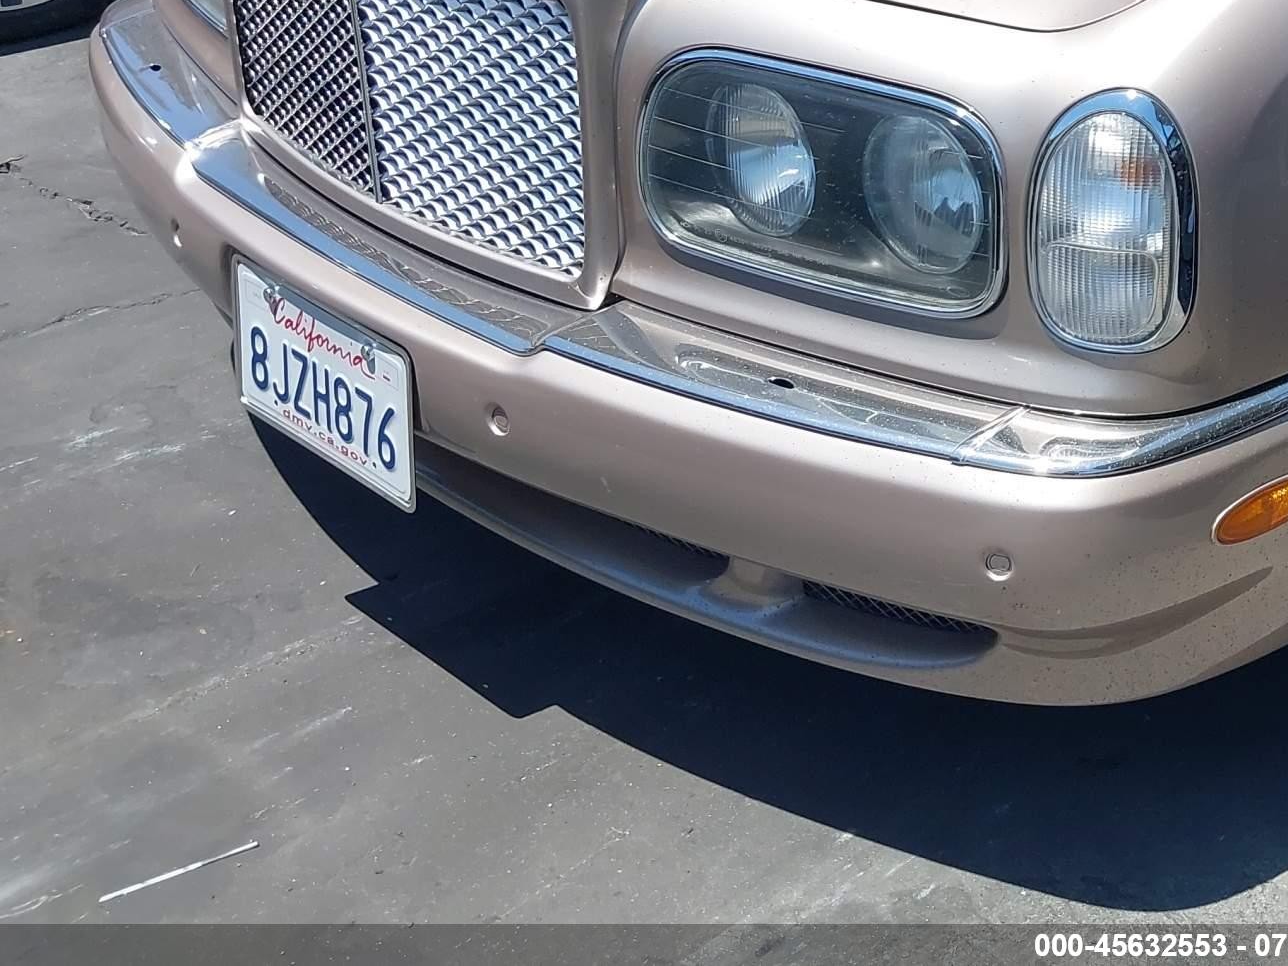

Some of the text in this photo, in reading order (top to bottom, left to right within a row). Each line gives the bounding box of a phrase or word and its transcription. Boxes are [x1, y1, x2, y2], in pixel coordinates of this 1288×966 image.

[271, 296, 376, 380] California
[250, 326, 396, 470] 8JZH876
[282, 408, 368, 466] dmv.ca.gov
